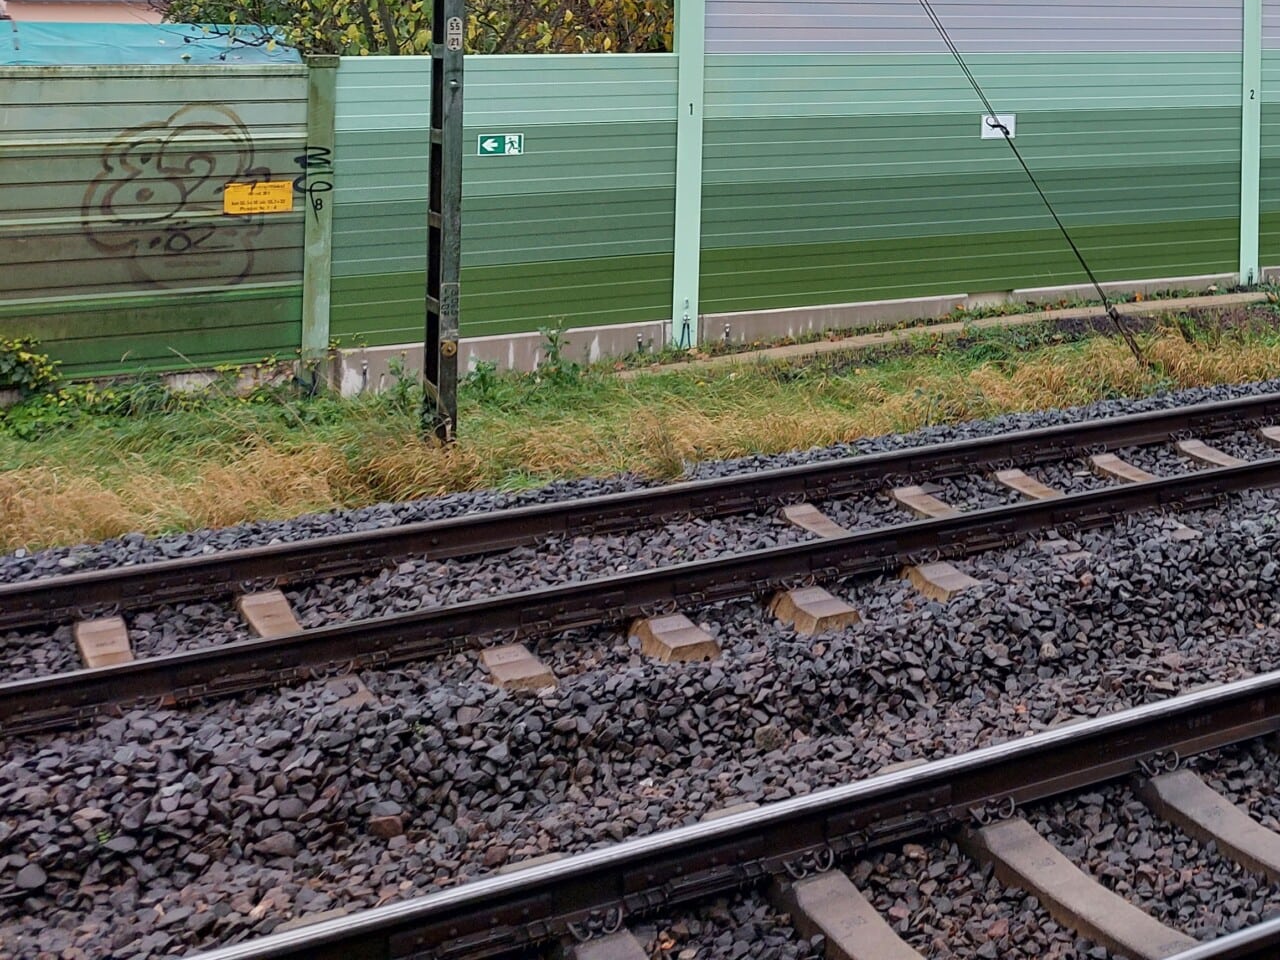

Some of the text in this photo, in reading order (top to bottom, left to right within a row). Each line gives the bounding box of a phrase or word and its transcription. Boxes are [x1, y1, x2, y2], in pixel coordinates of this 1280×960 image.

[450, 22, 460, 31] 55
[450, 37, 459, 46] 21
[1250, 89, 1255, 100] 2
[315, 198, 323, 211] 8
